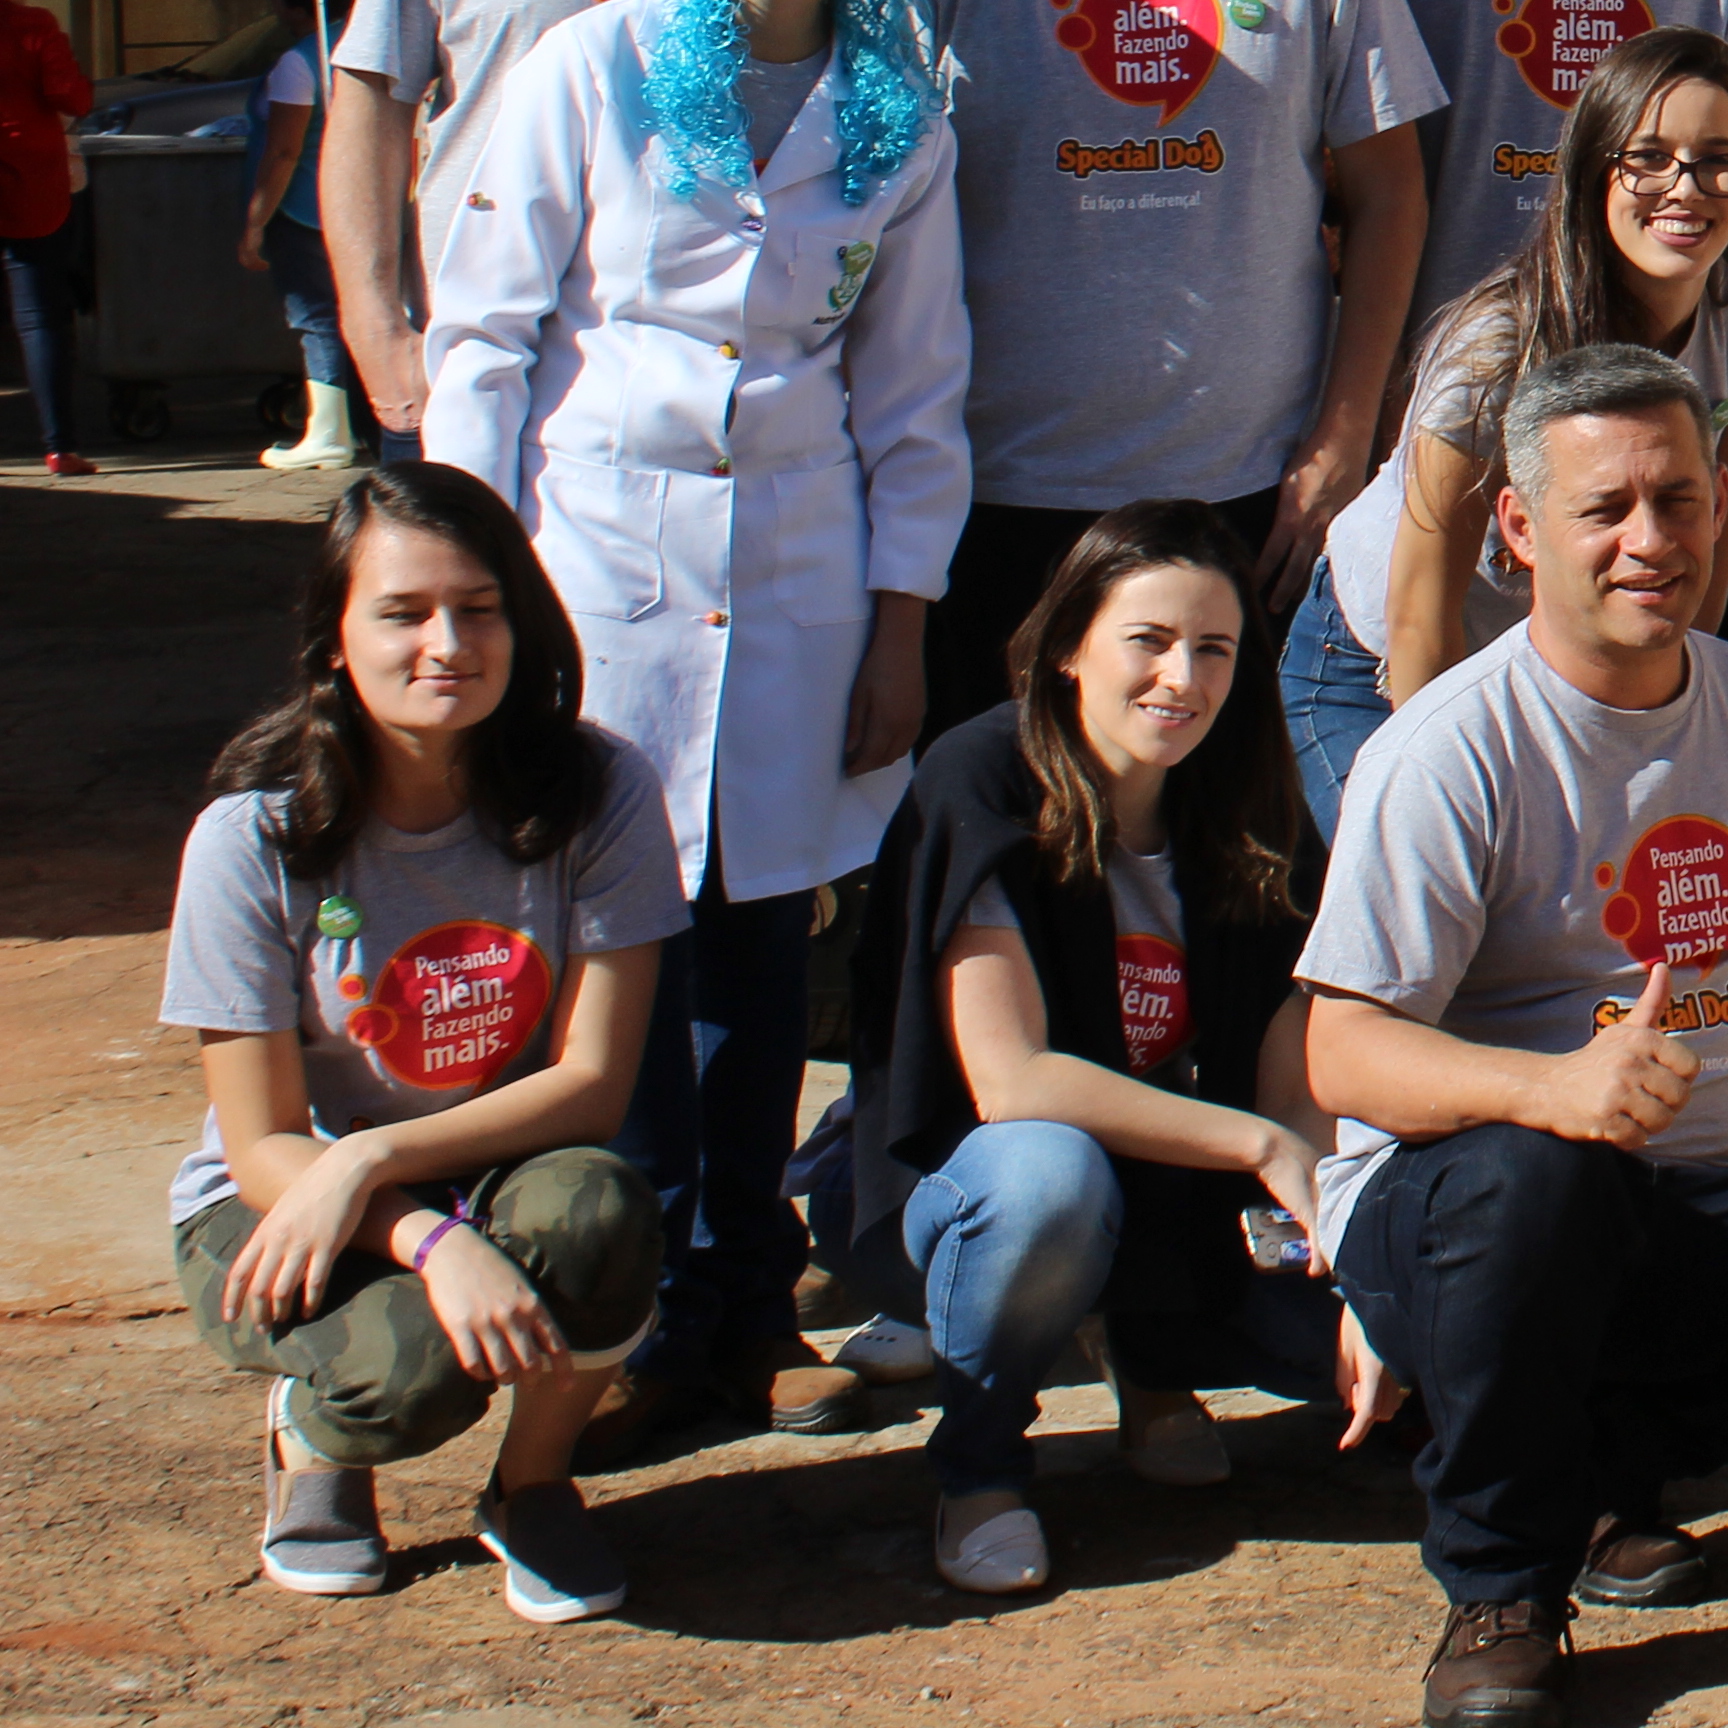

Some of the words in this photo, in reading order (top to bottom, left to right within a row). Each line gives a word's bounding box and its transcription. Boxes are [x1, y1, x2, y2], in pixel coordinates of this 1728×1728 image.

[1113, 1, 1188, 32] além.
[1113, 29, 1189, 55] Fazendo
[1115, 53, 1190, 85] mais.
[1057, 137, 1157, 178] Special
[1163, 128, 1225, 174] Dog
[414, 942, 510, 980] Pensando
[420, 974, 514, 1018] além.
[421, 1003, 514, 1042] Fazendo
[423, 1030, 510, 1072] mais.
